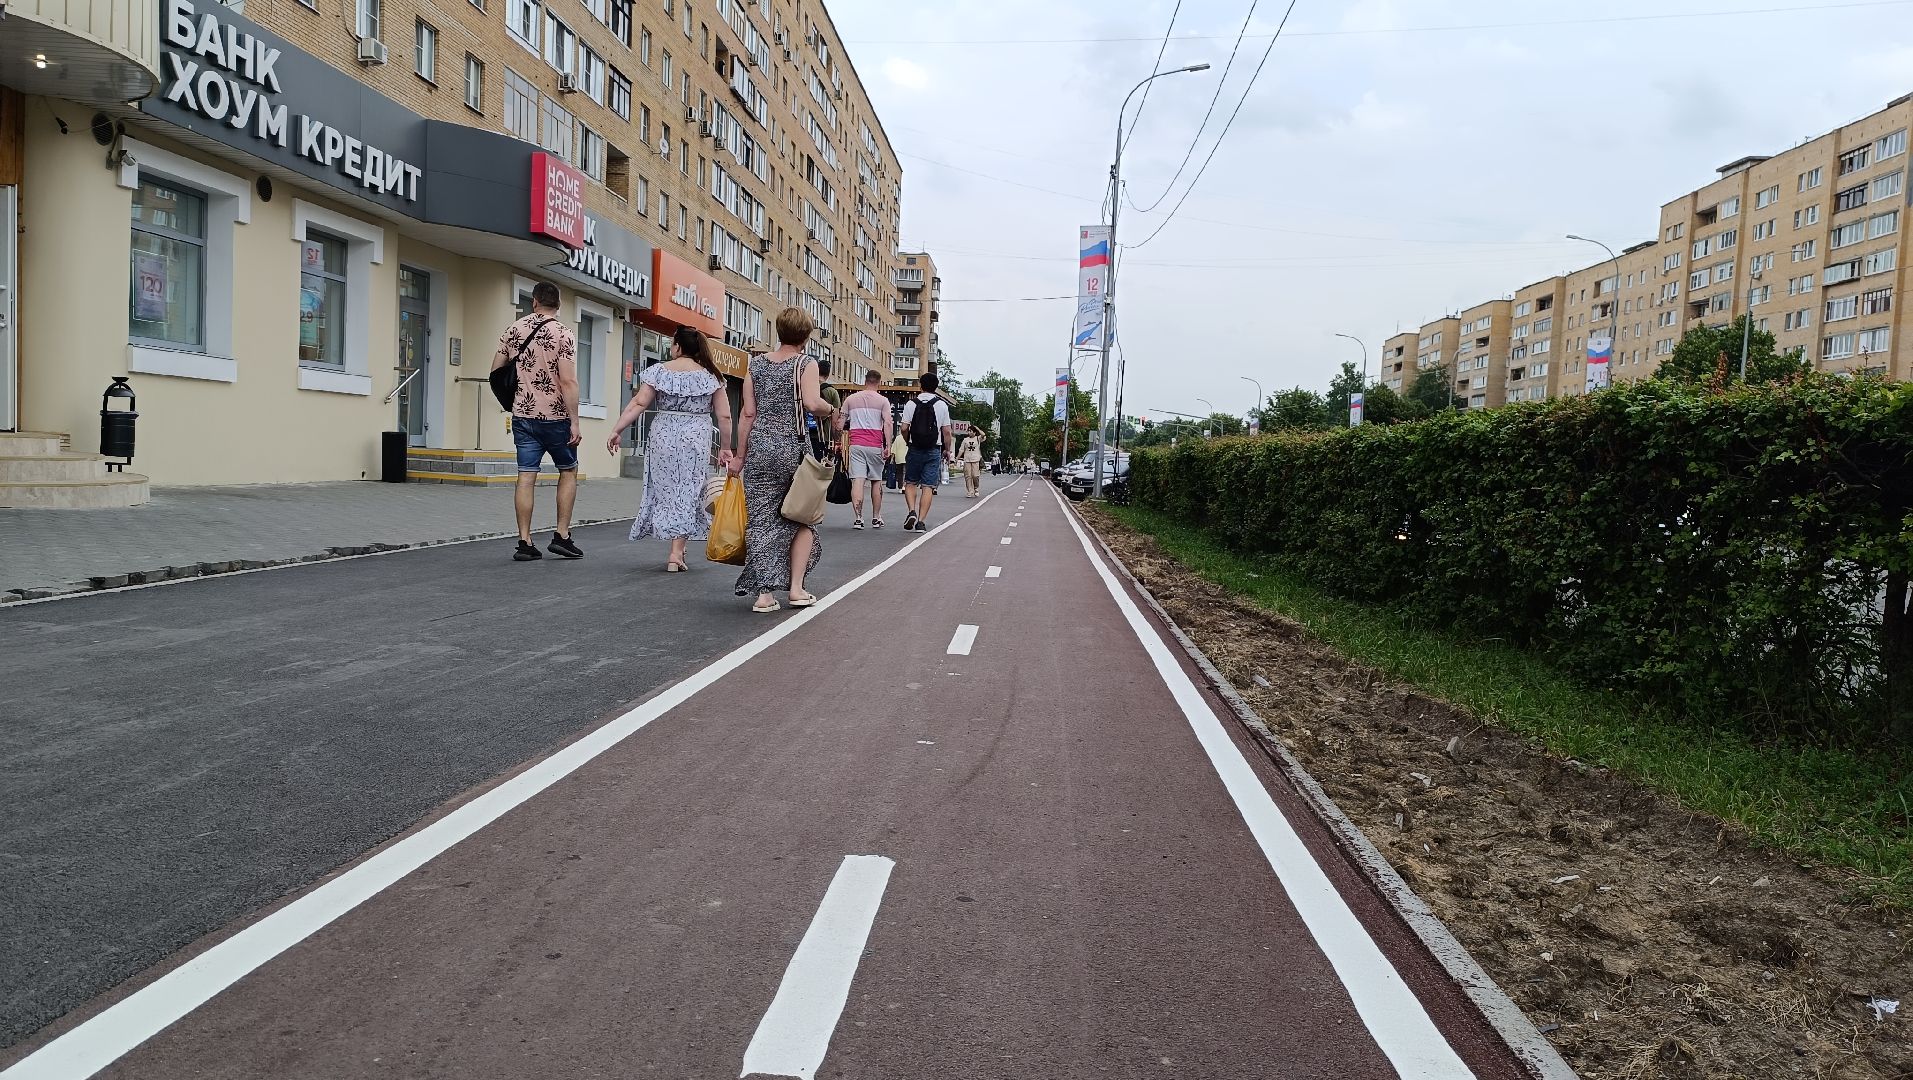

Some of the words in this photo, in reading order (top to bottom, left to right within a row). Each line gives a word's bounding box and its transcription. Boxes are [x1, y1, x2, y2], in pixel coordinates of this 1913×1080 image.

[167, 0, 281, 93] БАНК
[167, 51, 288, 148] ХОУМ
[298, 114, 422, 201] КРЕДИТ
[548, 164, 580, 199] HOME
[547, 187, 582, 220] CREDIT
[546, 209, 575, 238] BANK
[567, 246, 599, 277] ОУМ
[602, 255, 649, 297] КРЕДИТ
[1087, 278, 1099, 291] 12
